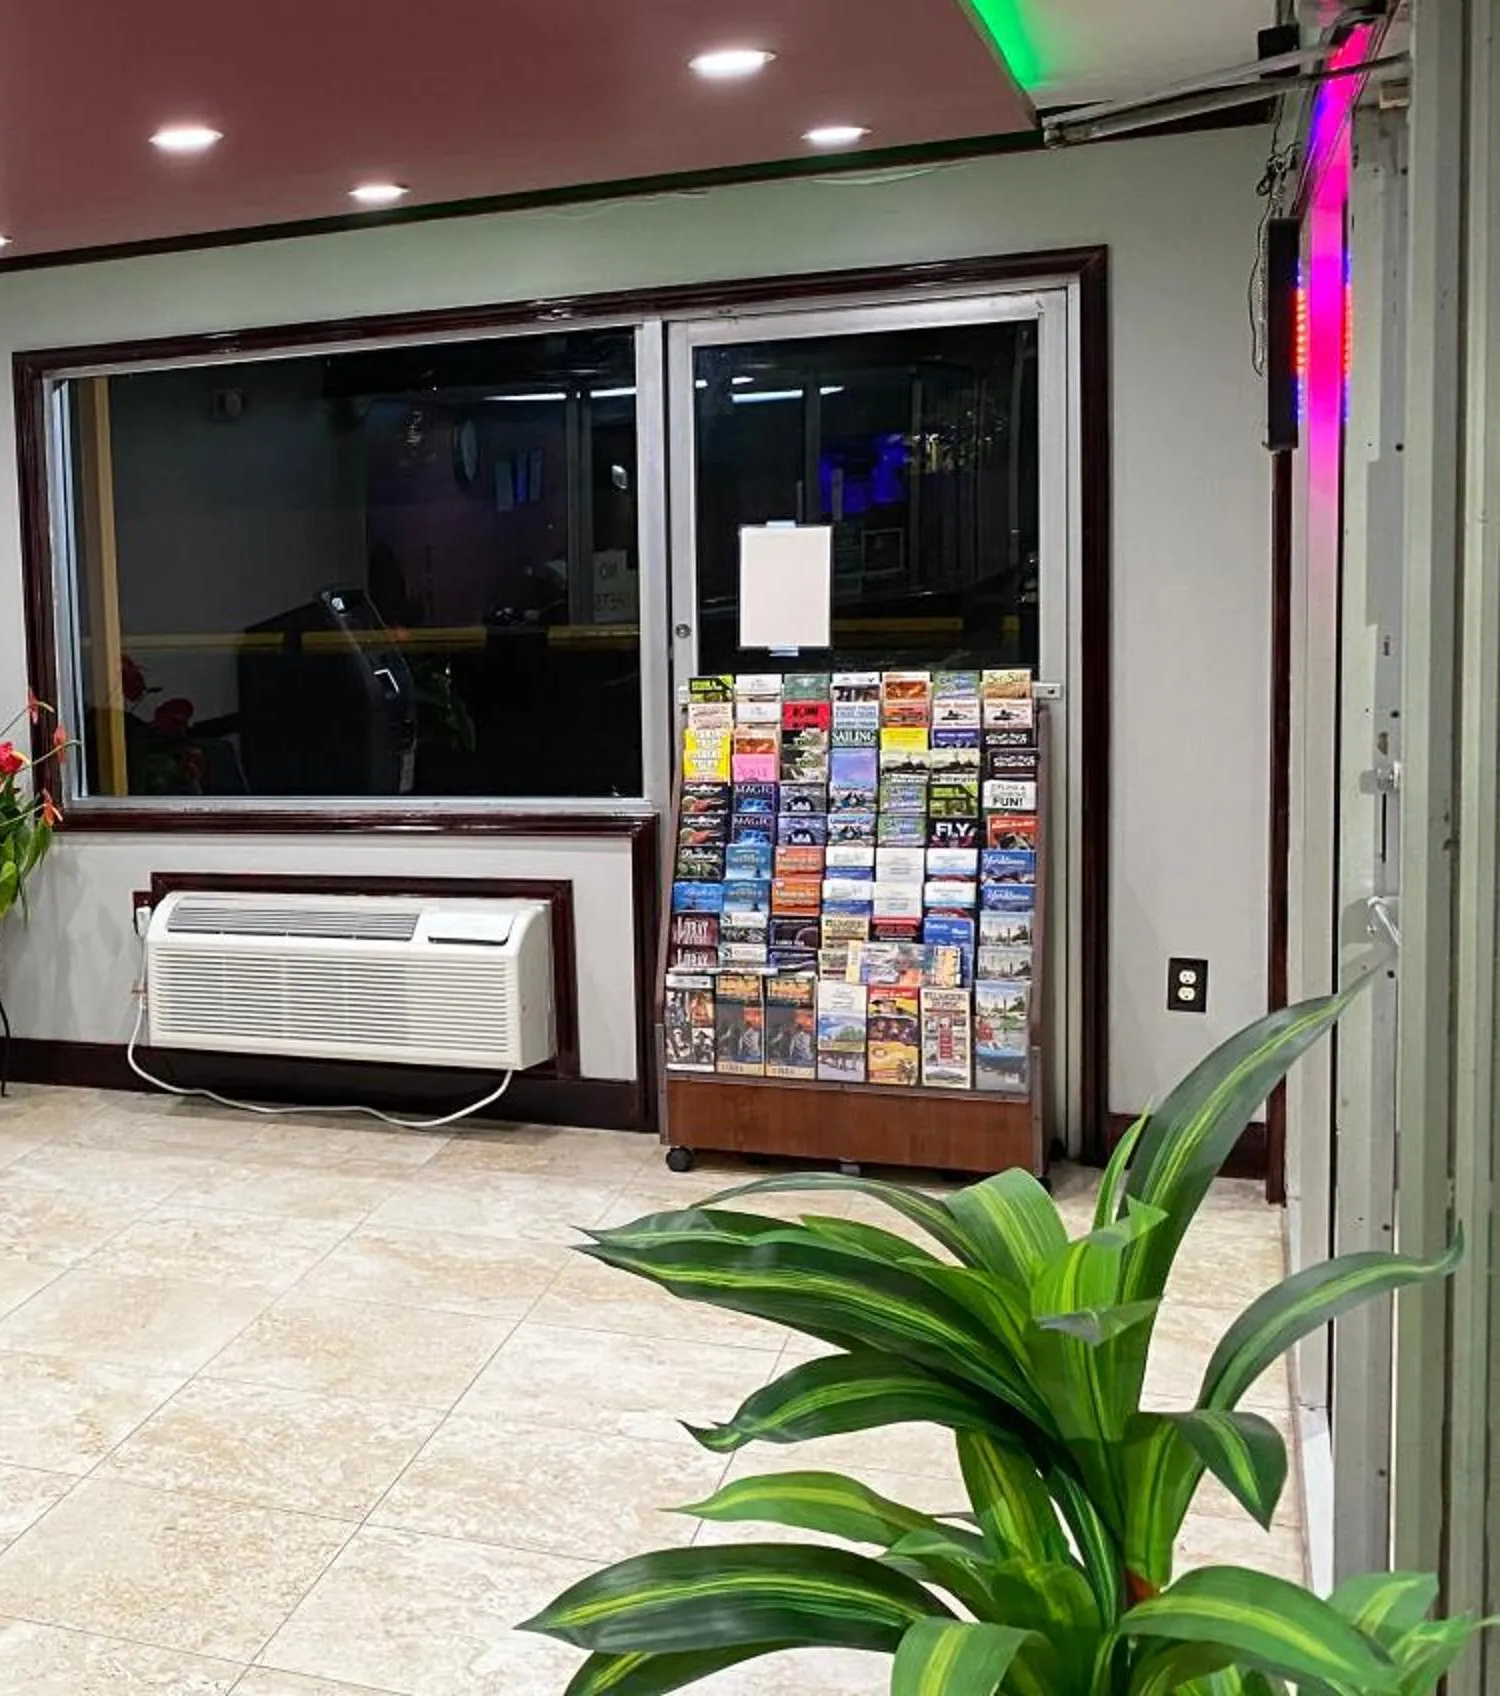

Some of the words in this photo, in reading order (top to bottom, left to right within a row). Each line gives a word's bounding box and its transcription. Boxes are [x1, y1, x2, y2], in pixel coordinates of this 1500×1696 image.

[831, 730, 877, 743] SAILING
[992, 796, 1024, 807] FUN!
[935, 822, 970, 837] FLY
